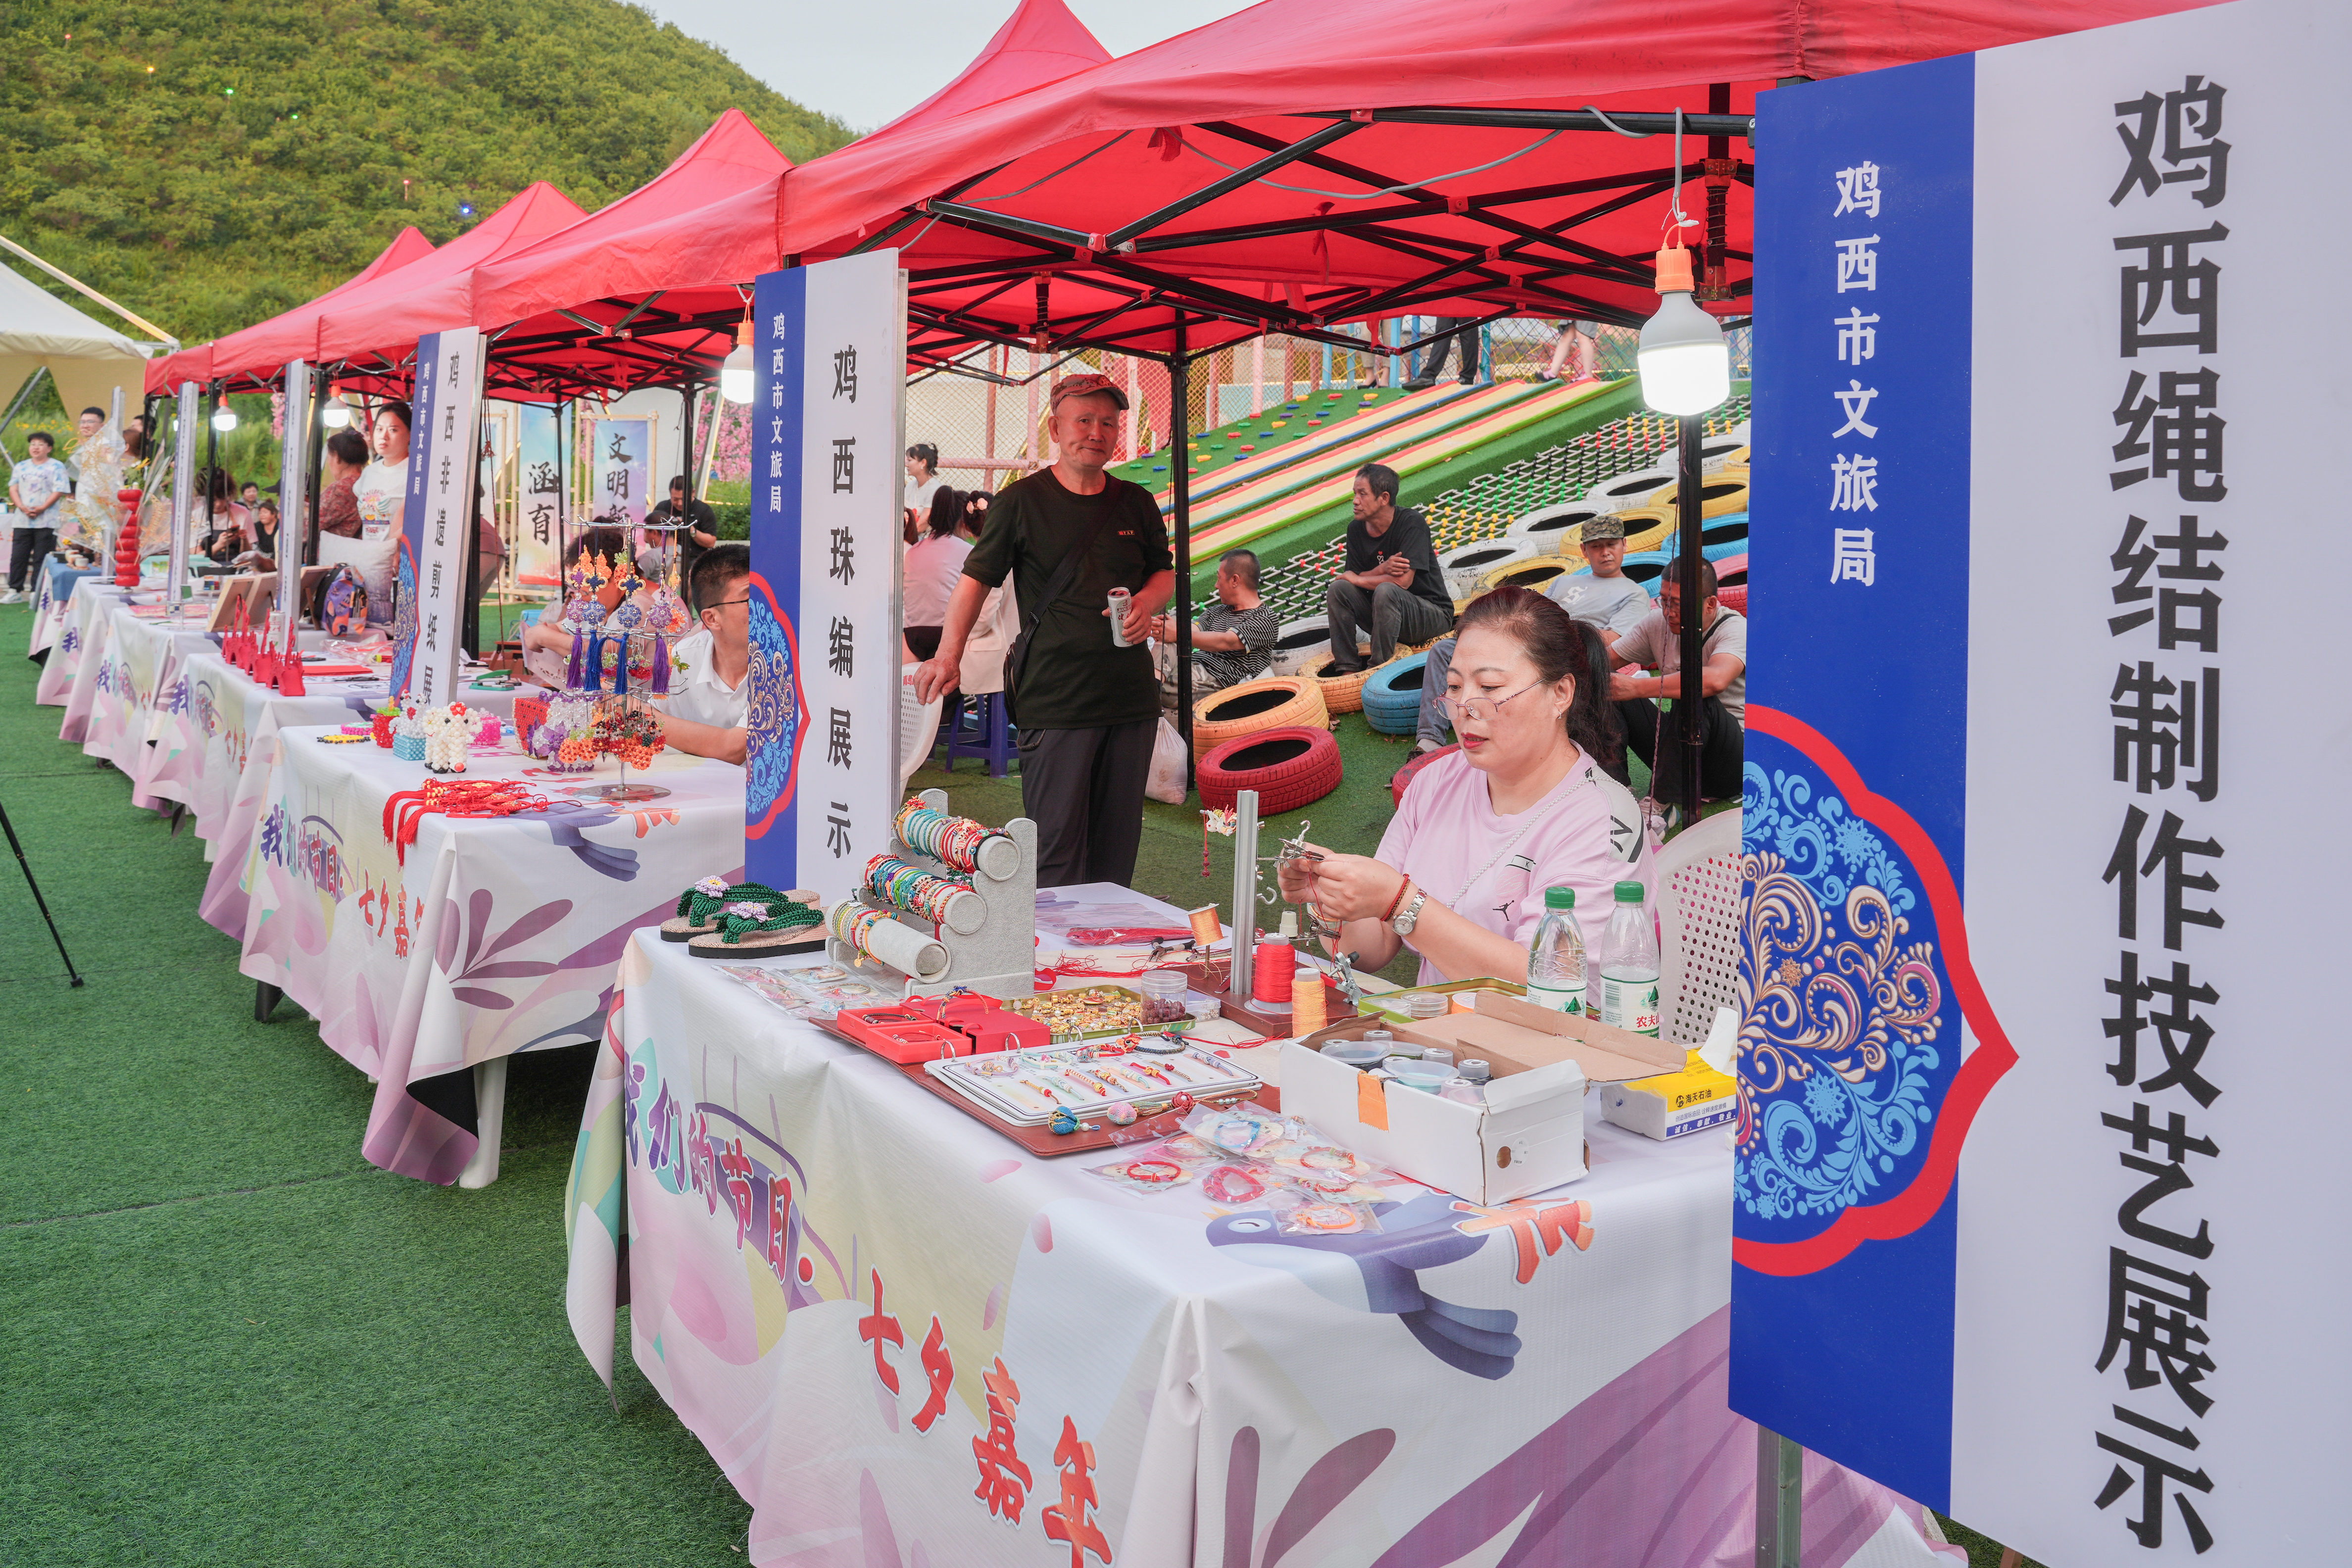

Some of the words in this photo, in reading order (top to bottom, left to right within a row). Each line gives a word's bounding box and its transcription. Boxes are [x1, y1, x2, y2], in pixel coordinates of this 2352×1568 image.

[413, 362, 432, 495] 鸡西市文旅局
[770, 312, 785, 513] 鸡西市文旅局
[1830, 161, 1881, 587] 鸡西市文旅局
[527, 461, 560, 545] 涵育
[827, 344, 858, 859] 鸡西珠编展示
[2094, 76, 2232, 1554] 鸡西绳结制作技艺展示
[1685, 1089, 1712, 1104] 海天石油
